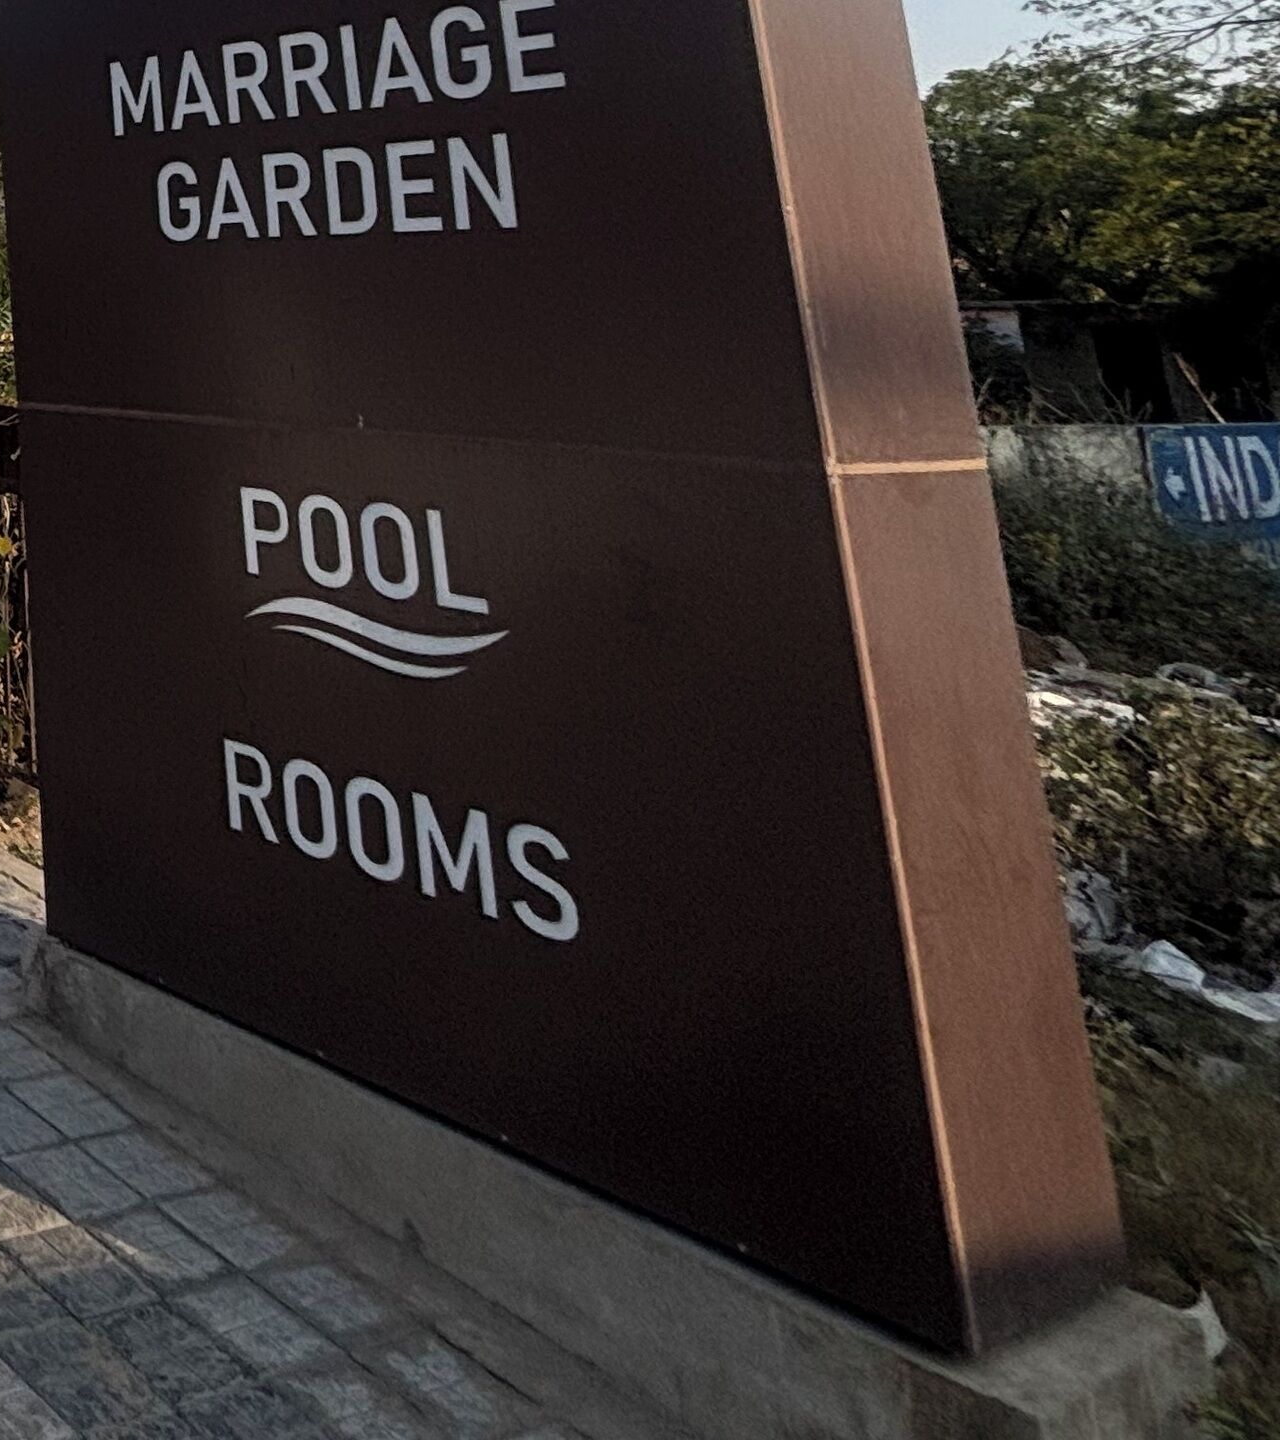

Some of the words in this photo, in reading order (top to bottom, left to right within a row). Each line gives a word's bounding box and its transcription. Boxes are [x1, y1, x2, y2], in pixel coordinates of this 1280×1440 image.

[156, 132, 518, 243] GARDEN
[1184, 435, 1280, 522] IND
[240, 486, 490, 615] POOL
[223, 738, 580, 942] ROOMS
